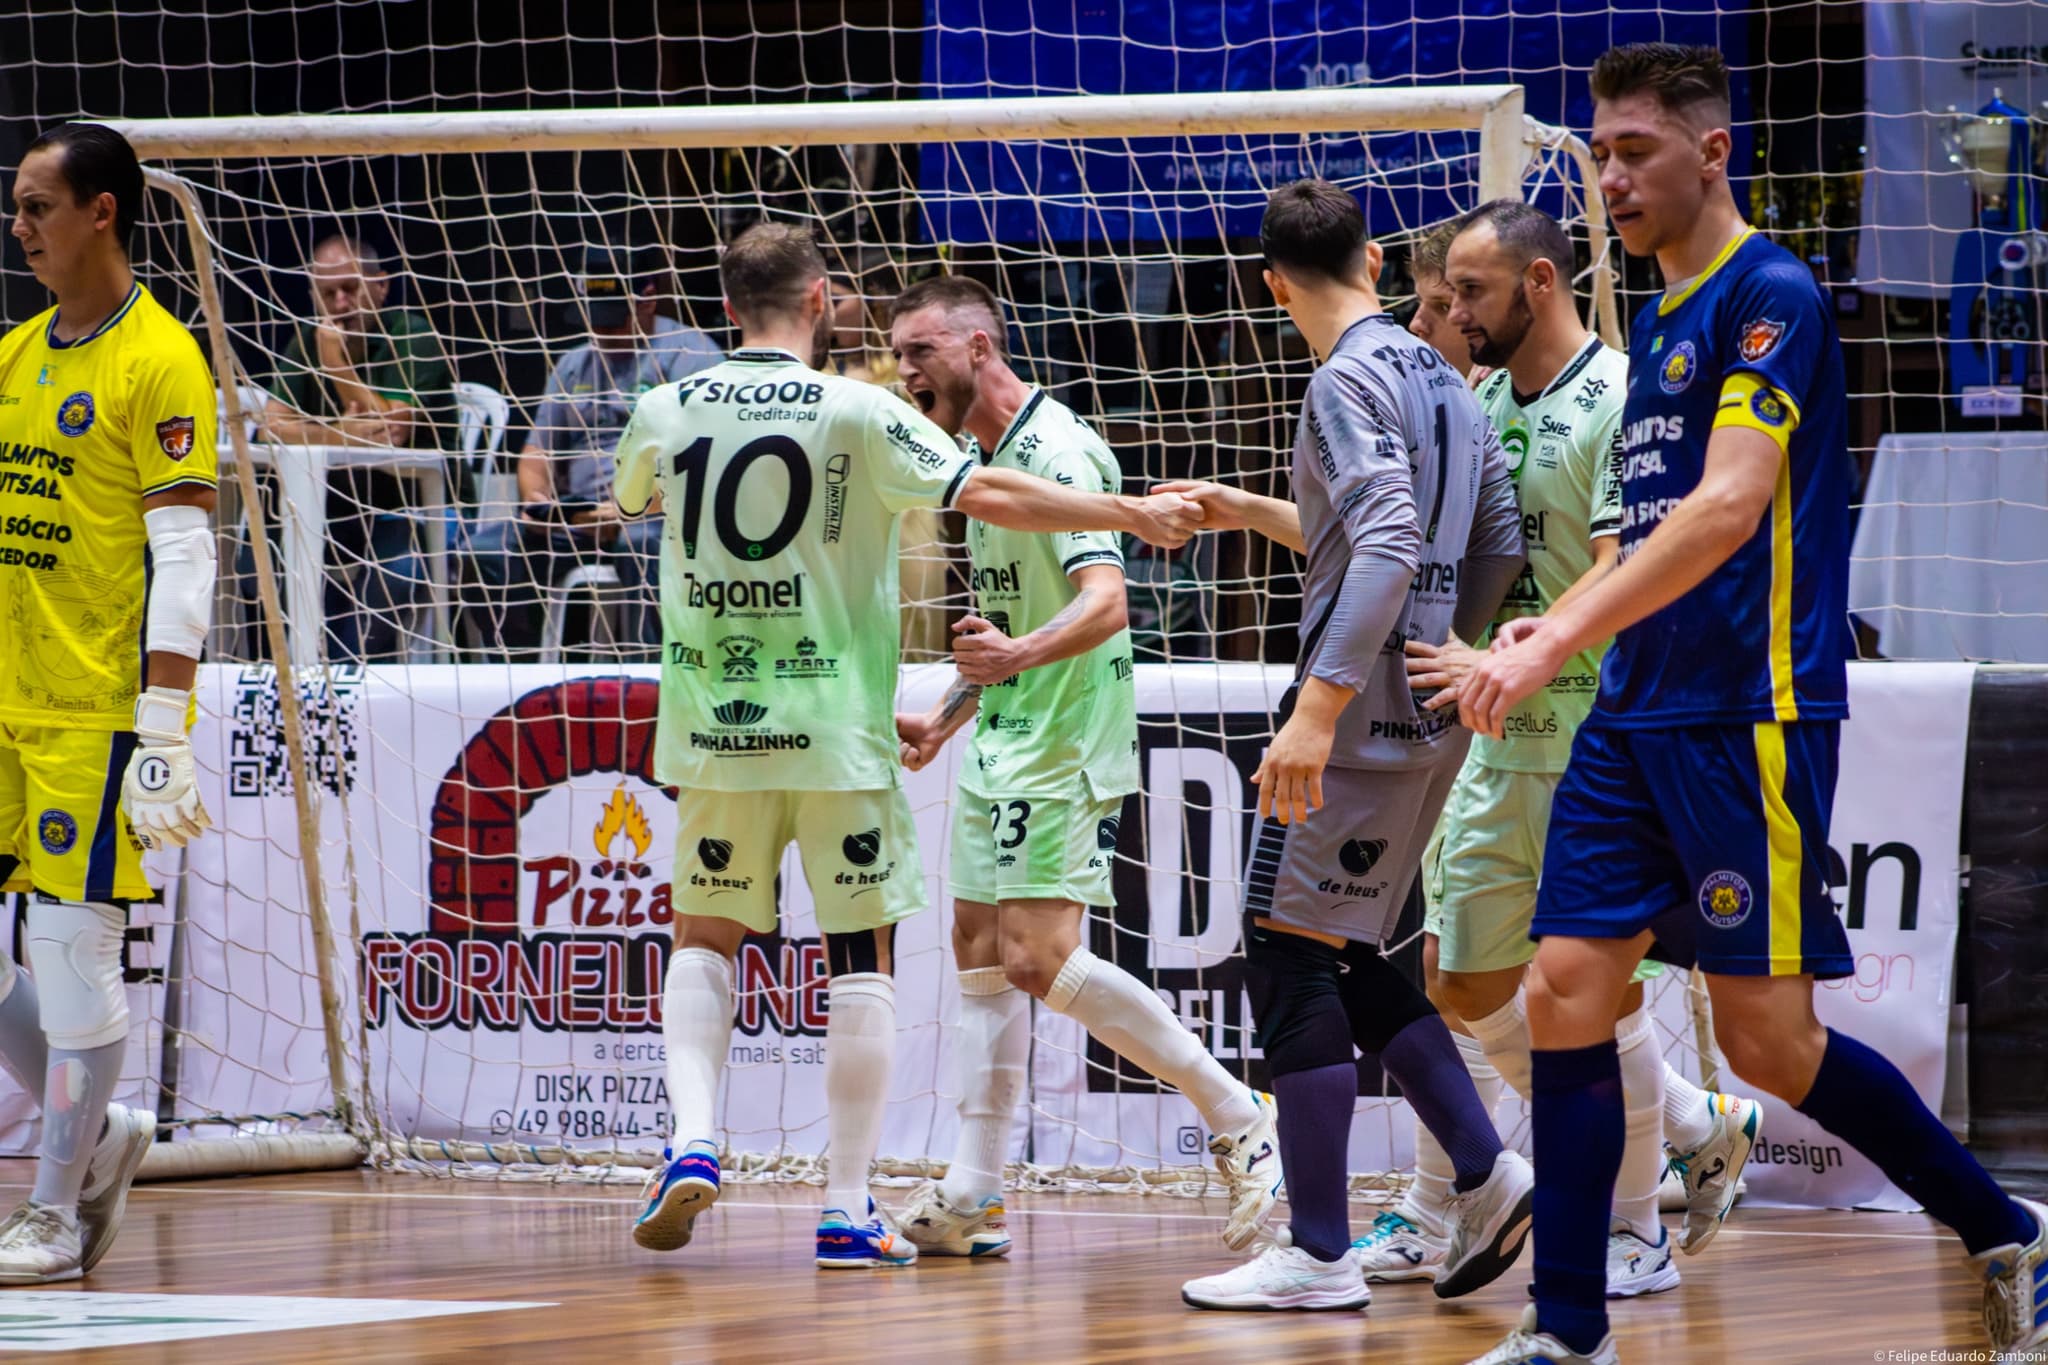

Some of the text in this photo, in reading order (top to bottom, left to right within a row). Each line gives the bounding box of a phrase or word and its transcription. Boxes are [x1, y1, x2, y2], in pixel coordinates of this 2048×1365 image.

[703, 381, 825, 404] SICOOB
[737, 408, 817, 422] Creditaipu
[886, 422, 946, 470] JUMPER!
[673, 434, 812, 561] 10
[5, 514, 73, 543] SÓCIO
[775, 659, 838, 669] START
[46, 694, 96, 711] Palmitos
[690, 732, 811, 751] PINHALZINHO
[690, 873, 748, 890] de heus
[834, 871, 854, 885] de
[1318, 878, 1379, 898] de heus
[524, 855, 673, 927] Pizza
[363, 937, 828, 1032] FORNELLNE
[594, 1045, 606, 1060] a
[732, 1043, 784, 1063] mais
[536, 1075, 670, 1106] DISK PIZZA
[518, 1110, 548, 1135] 49
